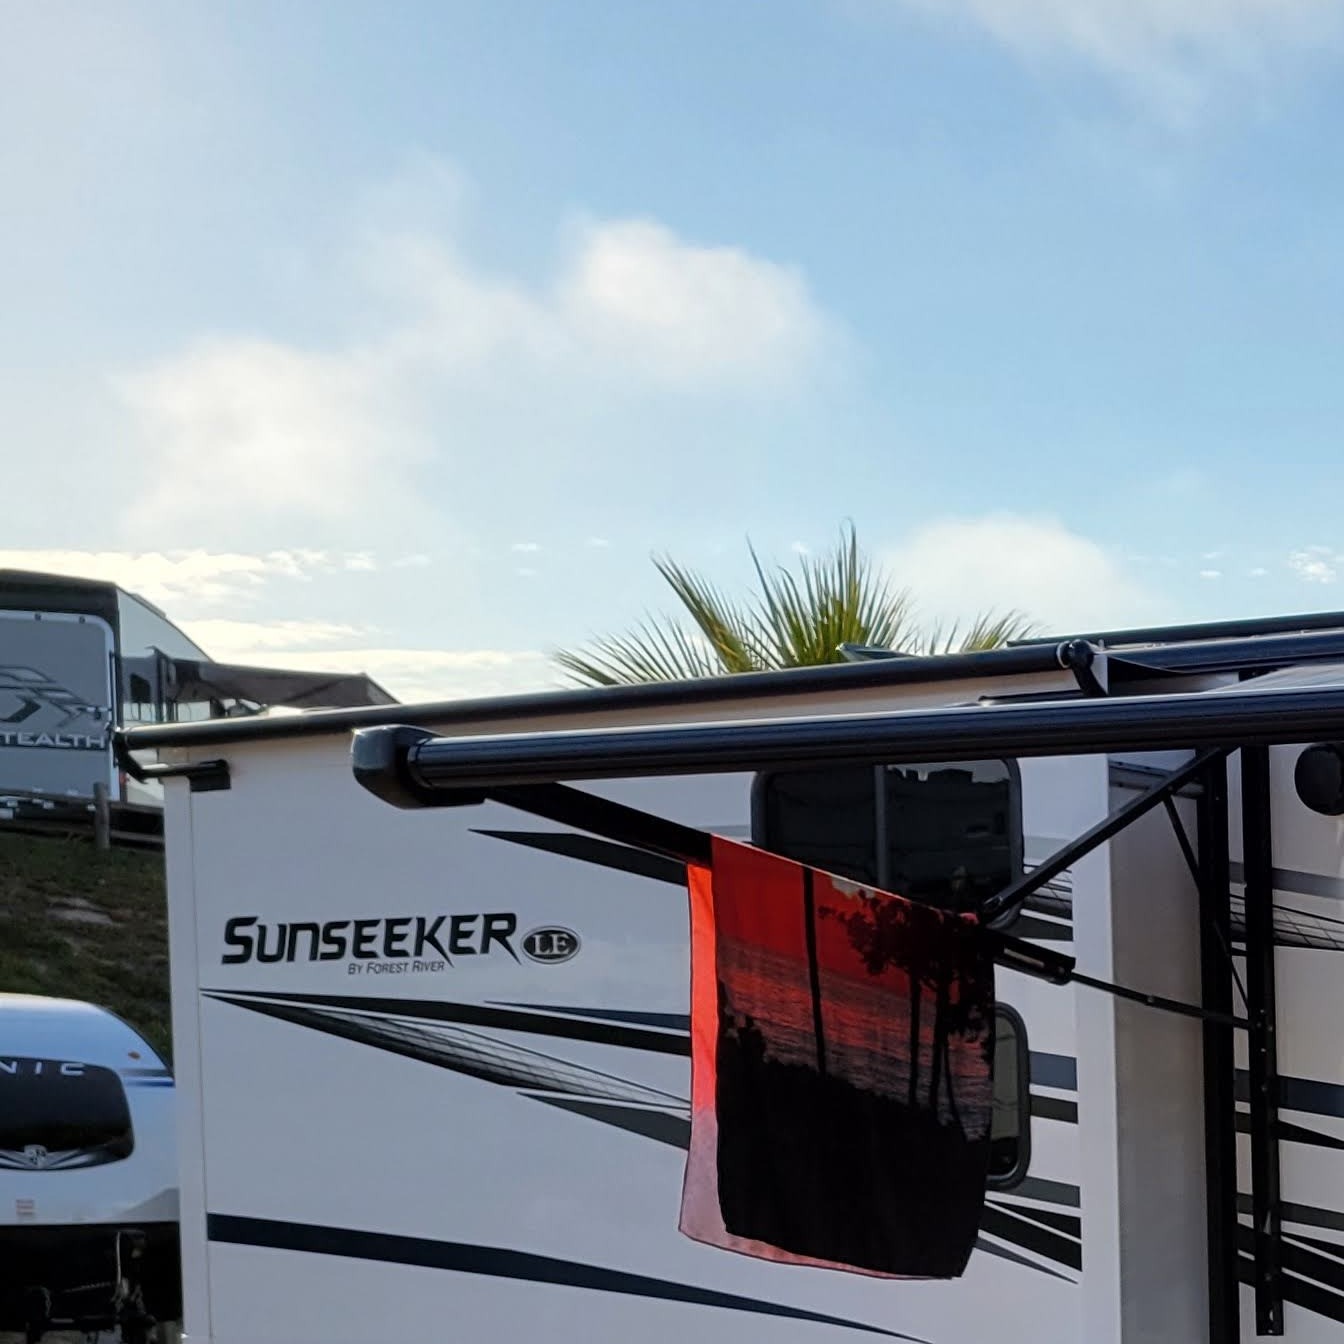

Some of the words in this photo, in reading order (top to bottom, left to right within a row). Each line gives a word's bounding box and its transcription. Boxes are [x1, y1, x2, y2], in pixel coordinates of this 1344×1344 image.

[532, 933, 570, 955] LE
[347, 963, 363, 975] BY
[366, 961, 409, 975] FOREST
[412, 960, 446, 973] RIVER
